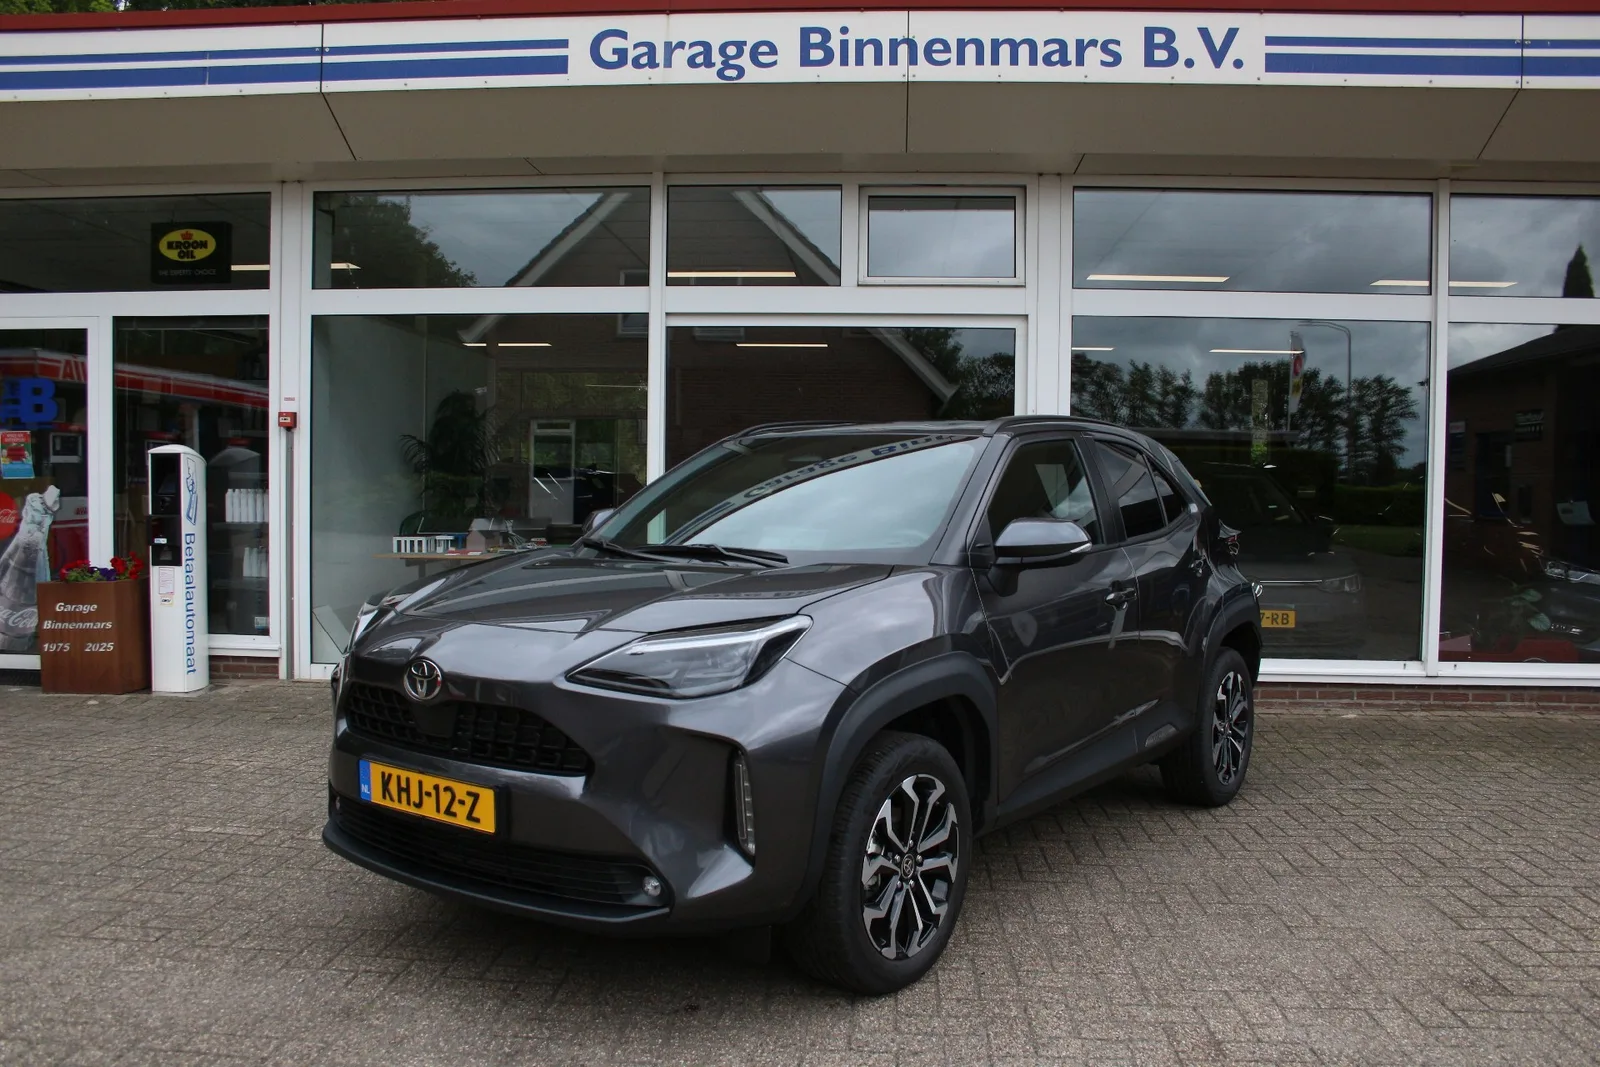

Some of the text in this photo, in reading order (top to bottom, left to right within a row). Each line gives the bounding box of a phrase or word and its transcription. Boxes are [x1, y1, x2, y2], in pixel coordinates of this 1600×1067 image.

[589, 25, 1244, 81] Garage Binnenmars B.V.
[167, 240, 208, 250] KROON
[178, 250, 196, 259] OIL
[55, 602, 98, 614] Garage
[185, 533, 197, 675] Betaalautomaat
[43, 620, 113, 630] Binnenmars
[43, 642, 114, 652] 1975 2025
[361, 783, 370, 794] NL
[381, 770, 481, 824] KHJ-12-Z
